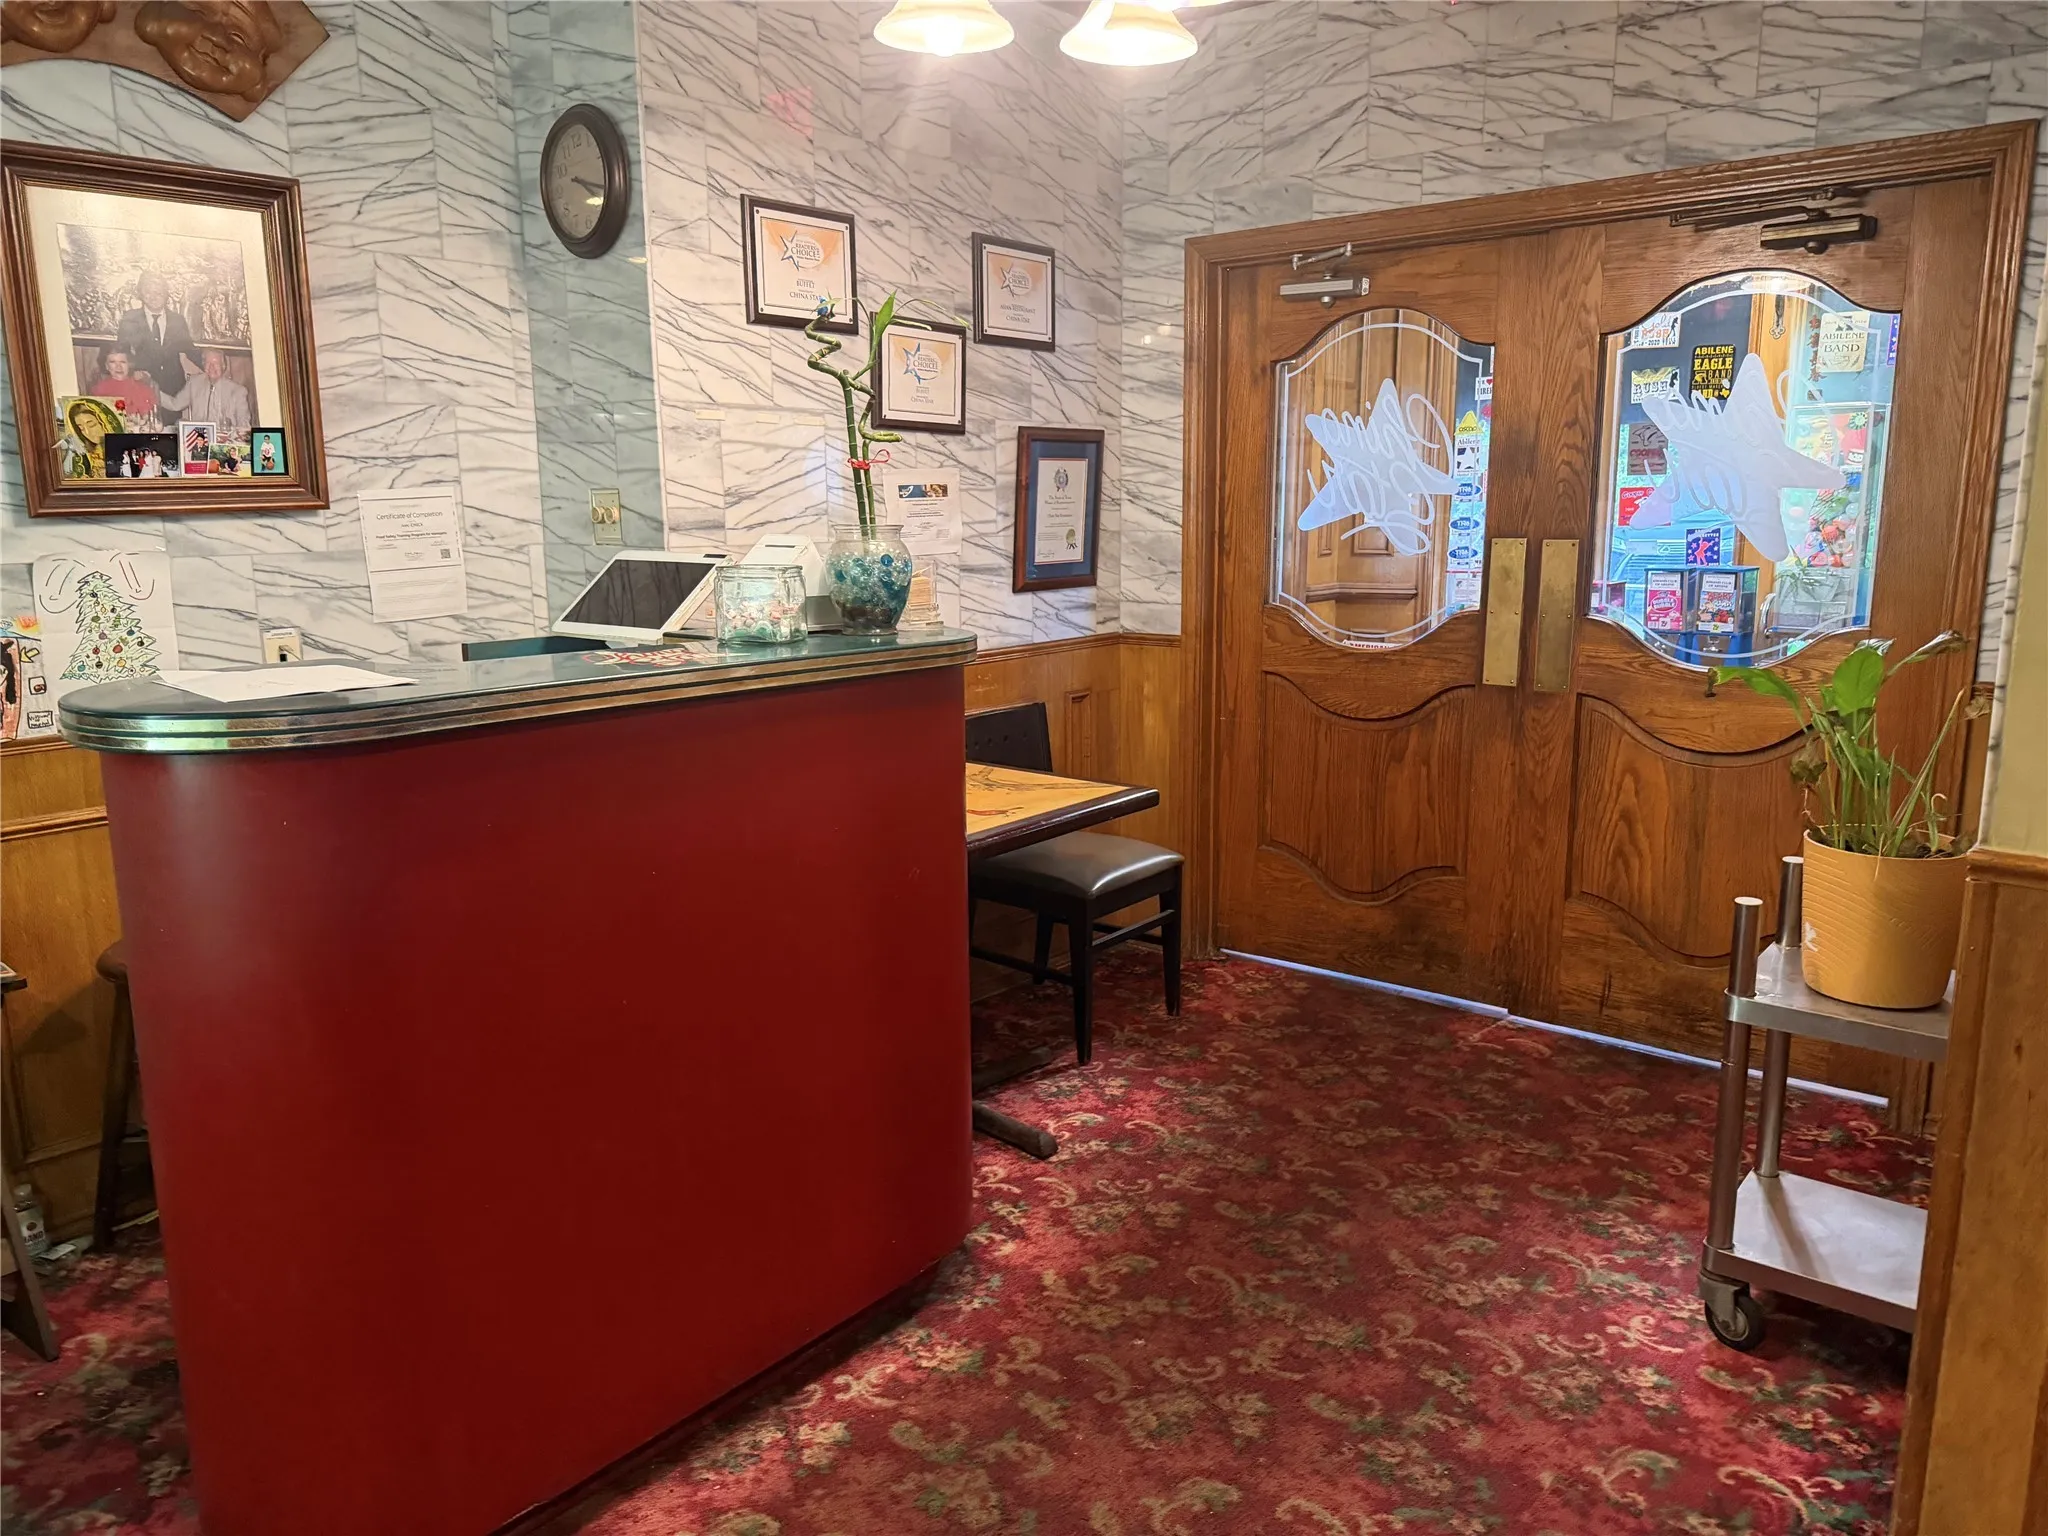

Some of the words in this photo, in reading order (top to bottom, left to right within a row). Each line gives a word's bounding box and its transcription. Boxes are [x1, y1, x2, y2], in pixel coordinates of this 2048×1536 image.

[570, 132, 582, 149] 12
[562, 145, 571, 159] 11
[556, 163, 568, 178] 10
[584, 215, 592, 230] 6
[789, 292, 808, 300] CHINA
[1823, 332, 1865, 341] ABILENE
[1695, 346, 1734, 355] ABILENE
[1824, 343, 1860, 353] BAND
[913, 359, 938, 369] CHOICE
[1694, 358, 1733, 370] EAGLE
[1708, 370, 1732, 379] BAND
[1632, 381, 1668, 395] RUSH
[376, 513, 406, 521] Certificate
[412, 511, 443, 519] Completion
